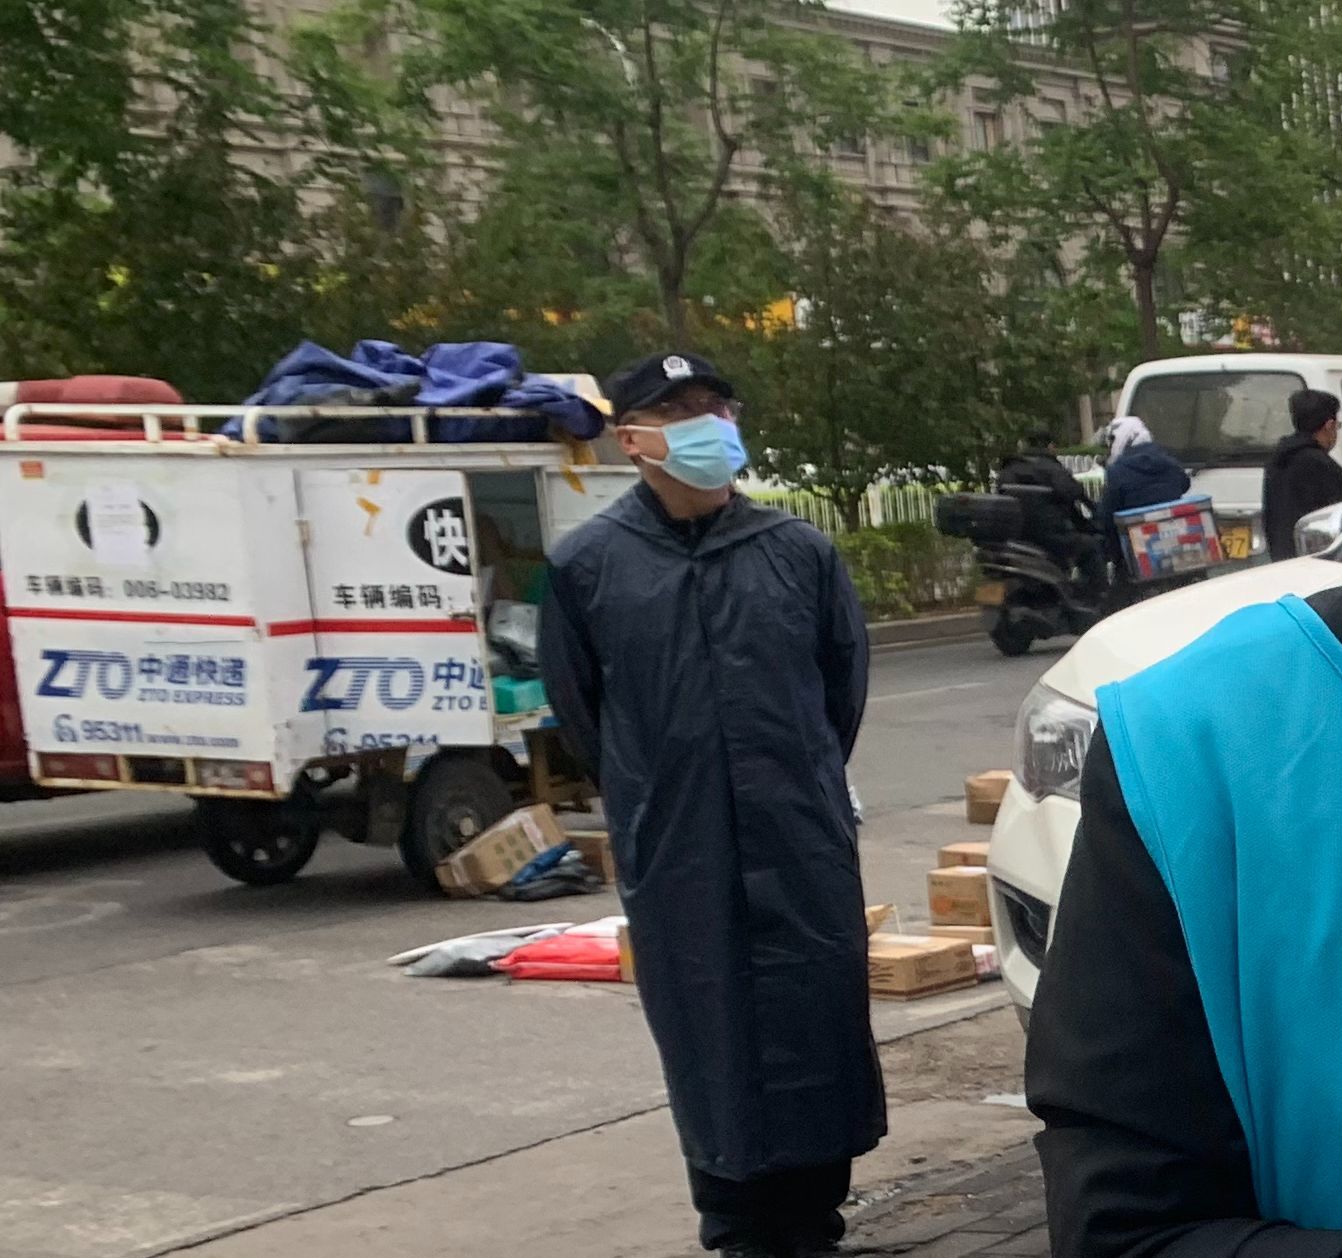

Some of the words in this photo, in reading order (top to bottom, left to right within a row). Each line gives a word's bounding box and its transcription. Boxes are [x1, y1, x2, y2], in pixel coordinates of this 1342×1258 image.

[35, 649, 133, 700] ZTO
[137, 654, 248, 687] 中通快递
[299, 656, 425, 712] ZTO
[173, 689, 248, 706] EXPRESS
[431, 696, 472, 711] ZTO
[81, 719, 144, 743] 95311
